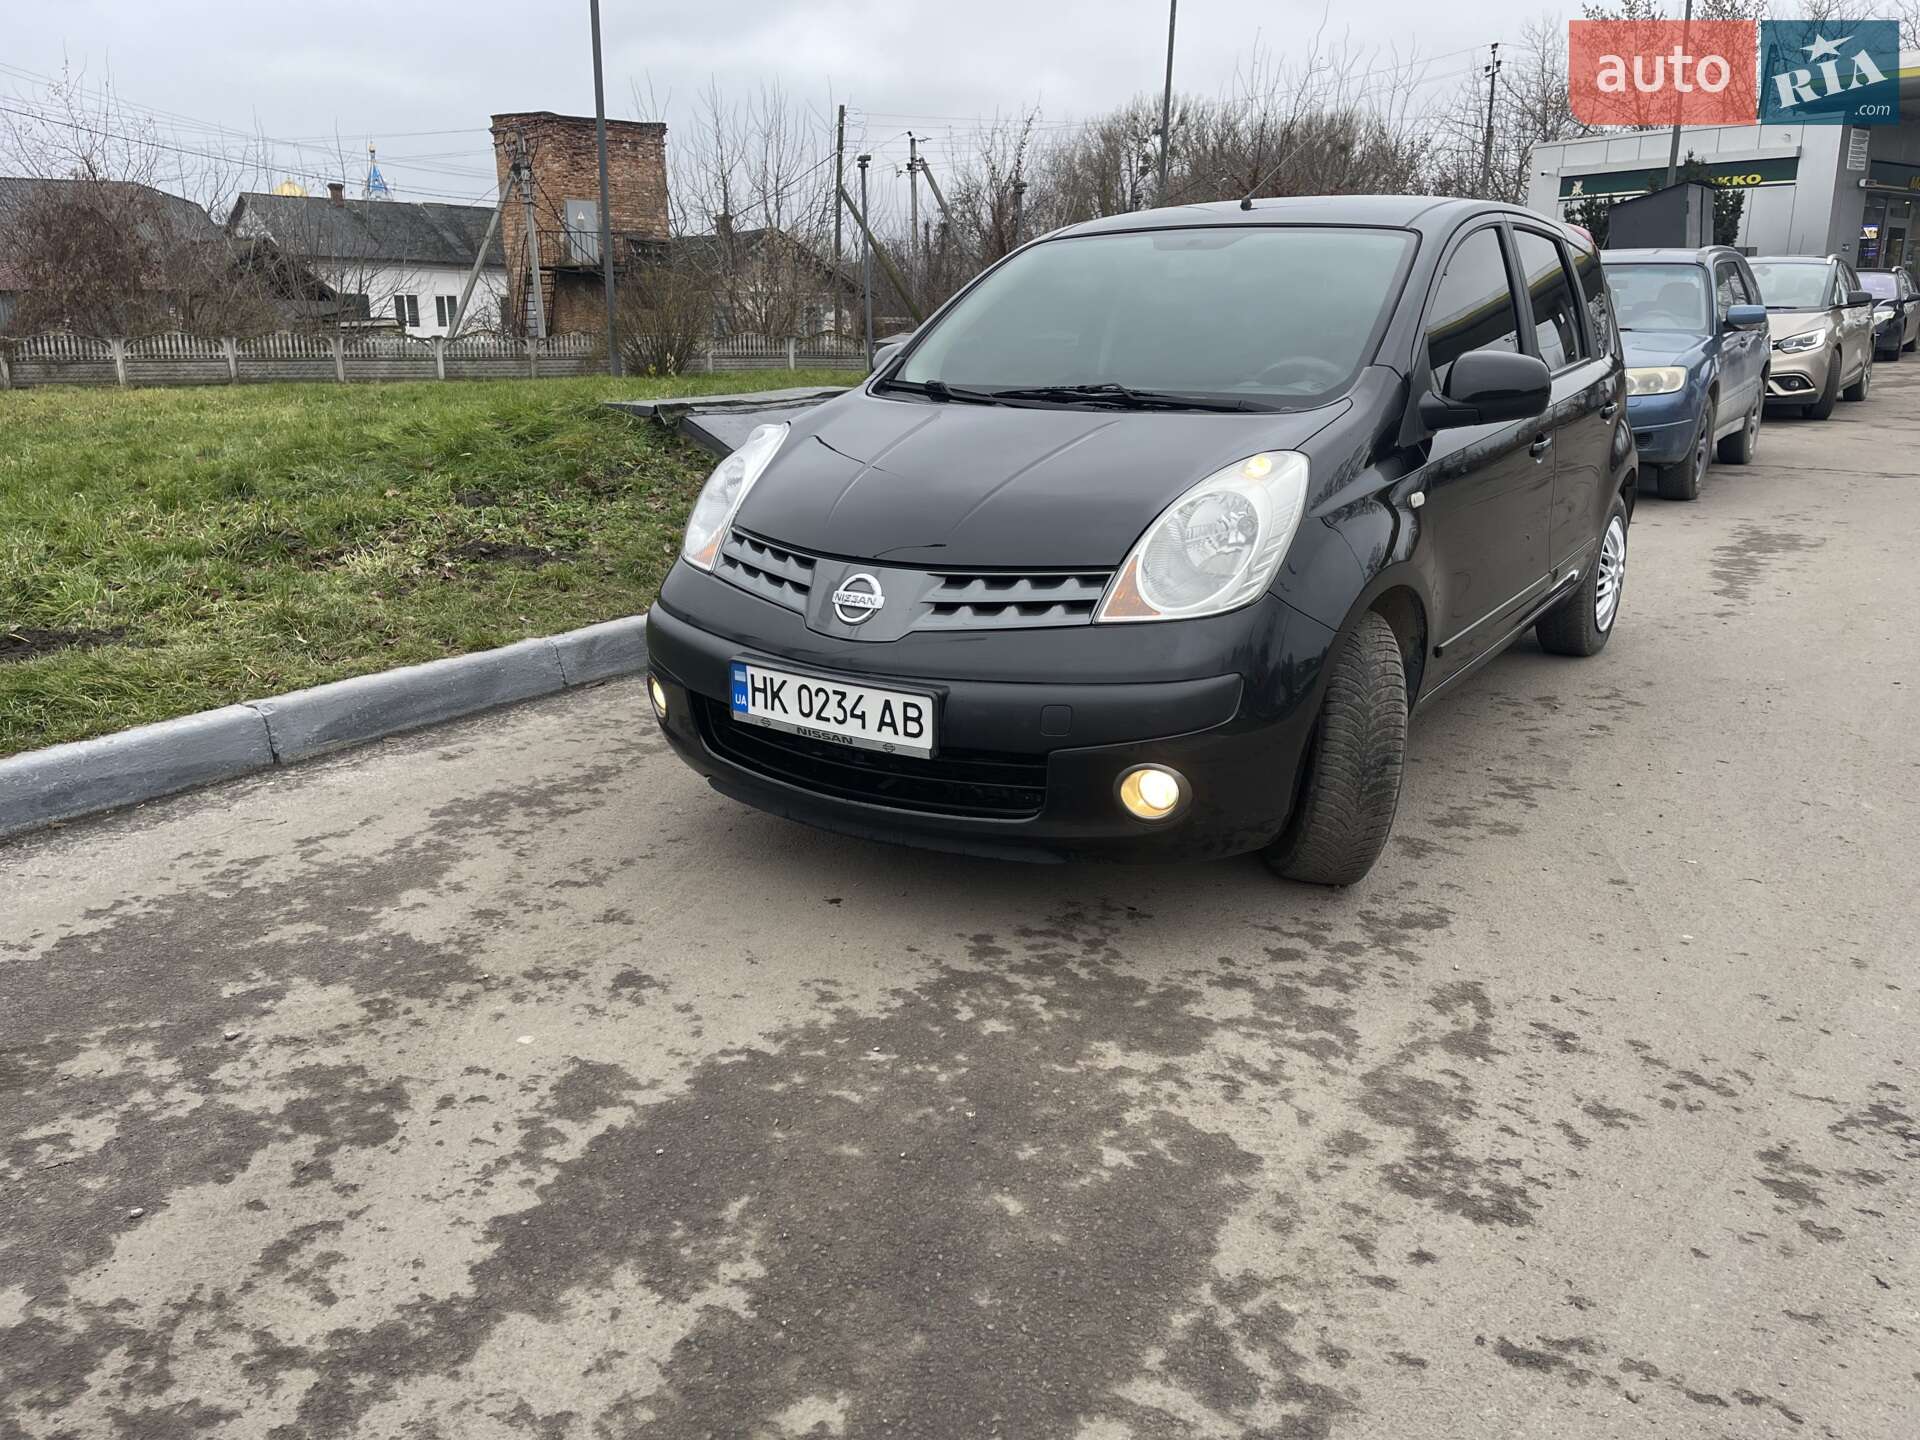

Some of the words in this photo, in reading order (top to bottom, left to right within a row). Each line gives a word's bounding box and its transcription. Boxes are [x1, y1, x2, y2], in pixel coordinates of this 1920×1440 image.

[834, 593, 877, 606] NISSAN
[735, 694, 747, 706] UA
[750, 674, 789, 714] HK
[797, 684, 866, 730] 0234
[877, 699, 924, 739] AB
[796, 726, 853, 745] NISSAN
